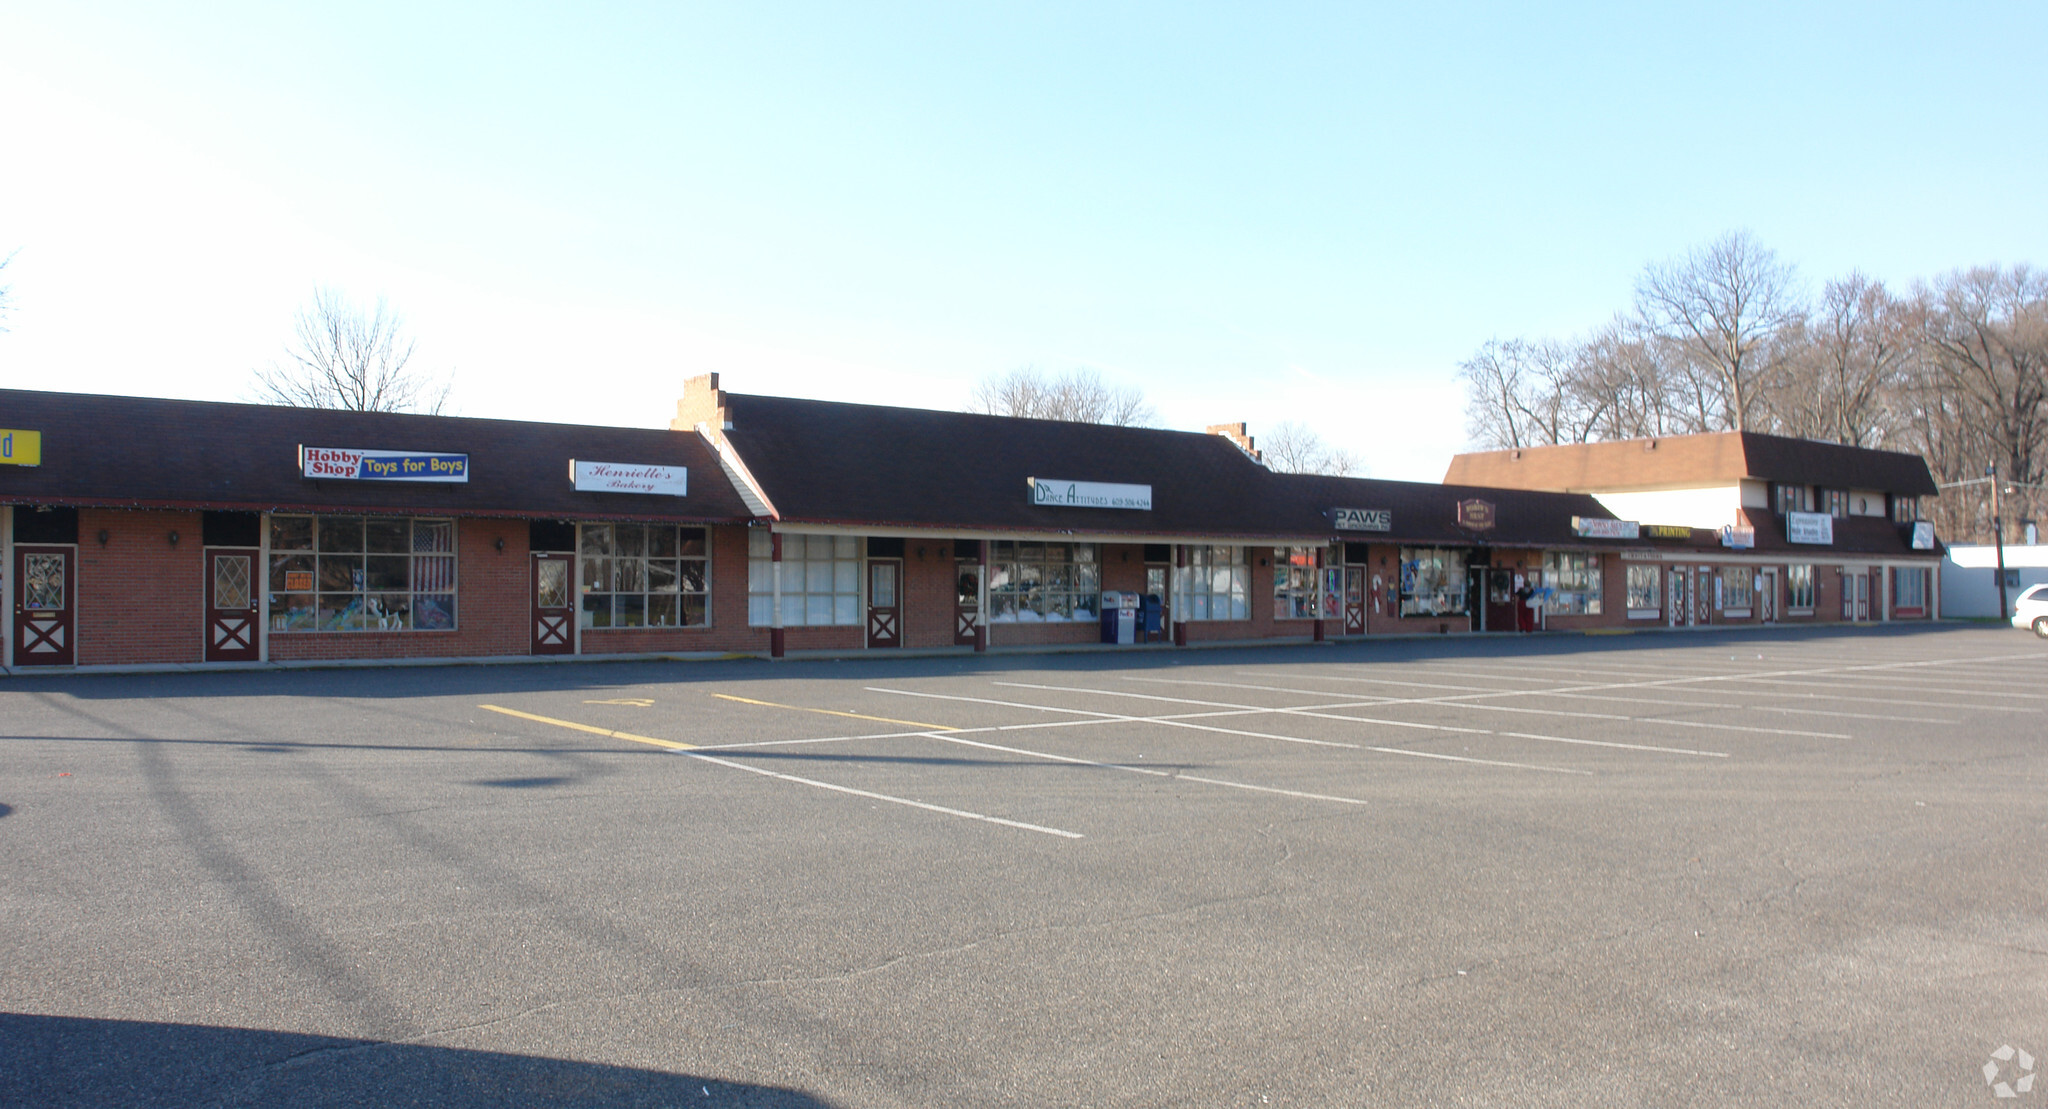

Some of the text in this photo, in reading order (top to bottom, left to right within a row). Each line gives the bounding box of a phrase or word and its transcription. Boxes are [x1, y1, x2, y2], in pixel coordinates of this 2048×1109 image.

[307, 449, 361, 465] Hobby
[312, 462, 356, 477] Shop
[364, 458, 463, 476] Toys for Boys
[589, 464, 671, 480] Henriette's
[606, 480, 655, 492] Bakery
[1335, 510, 1390, 524] PAWS
[1658, 526, 1691, 538] PRINTING
[287, 578, 313, 590] CLOSED
